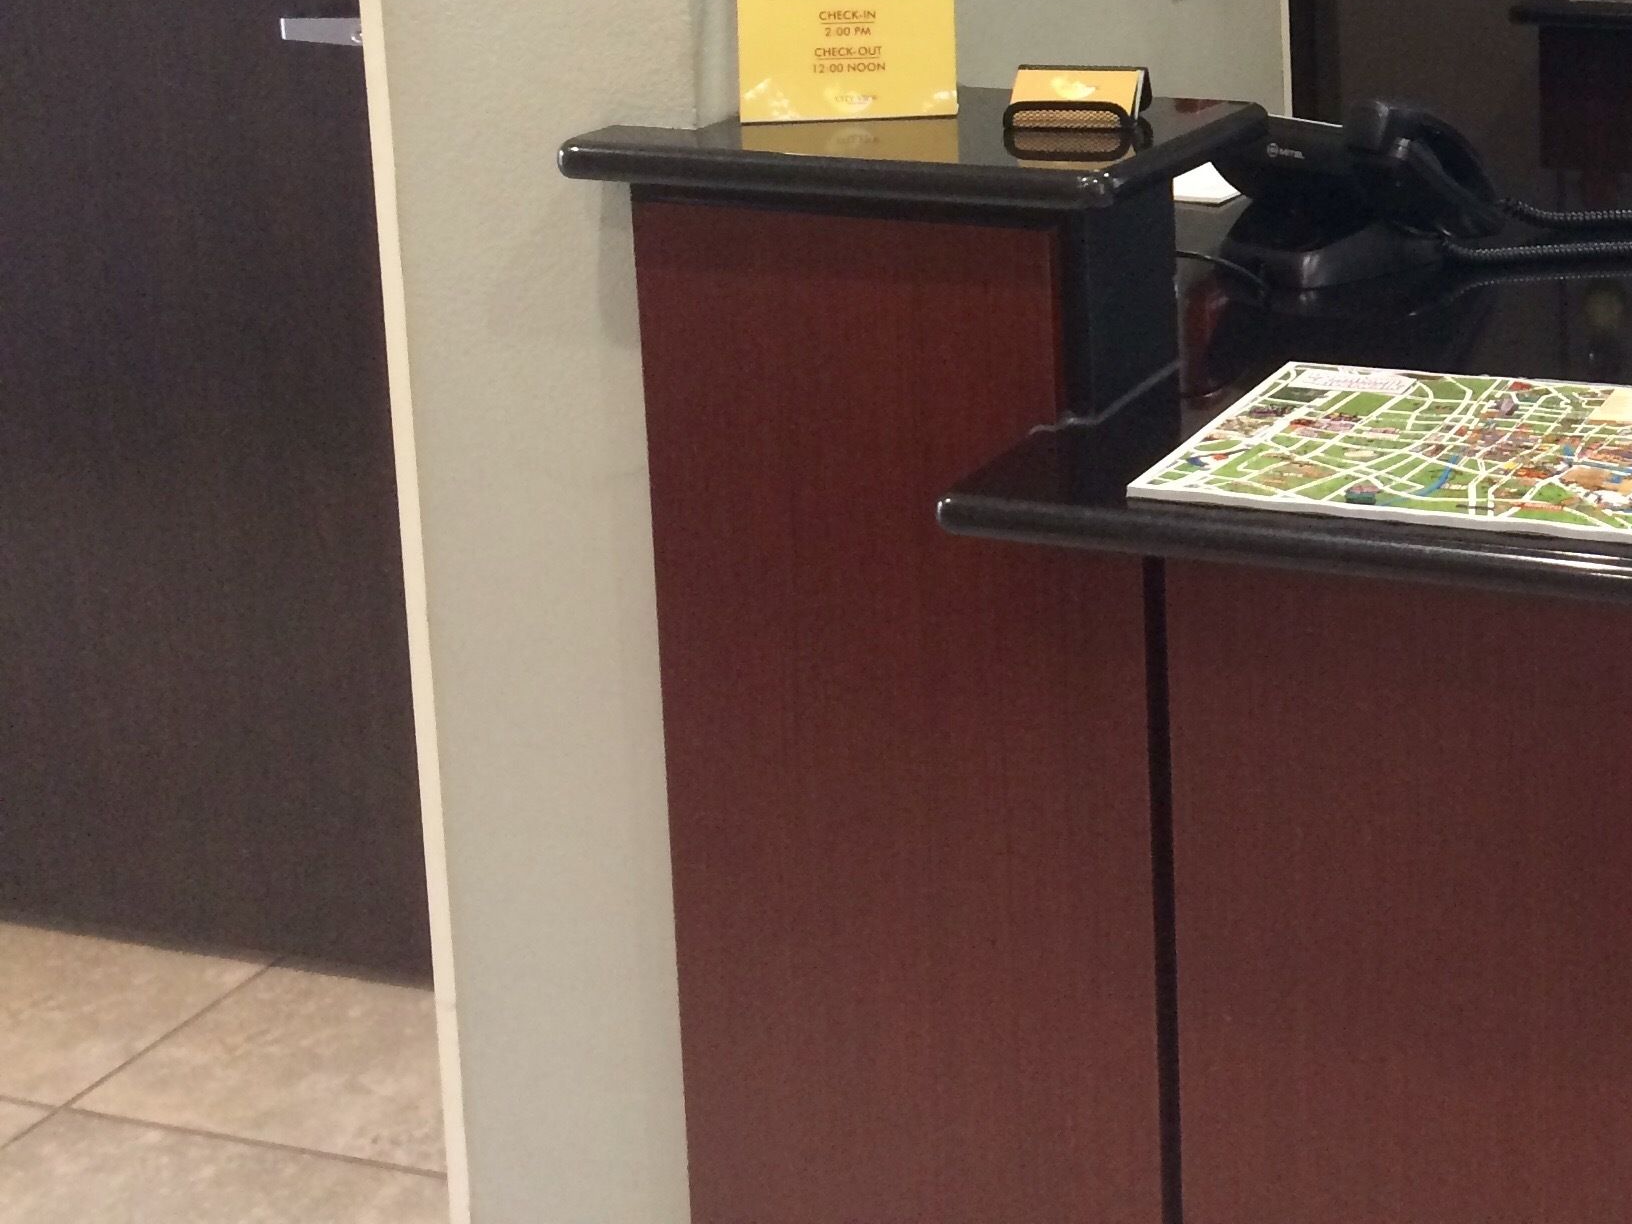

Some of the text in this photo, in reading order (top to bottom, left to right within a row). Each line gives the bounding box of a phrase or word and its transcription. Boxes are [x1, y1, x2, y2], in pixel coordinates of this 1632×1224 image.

[818, 9, 877, 21] CHECK-IN
[854, 26, 872, 36] PM
[814, 45, 883, 58] CHECK-OUT
[847, 62, 886, 73] NOON
